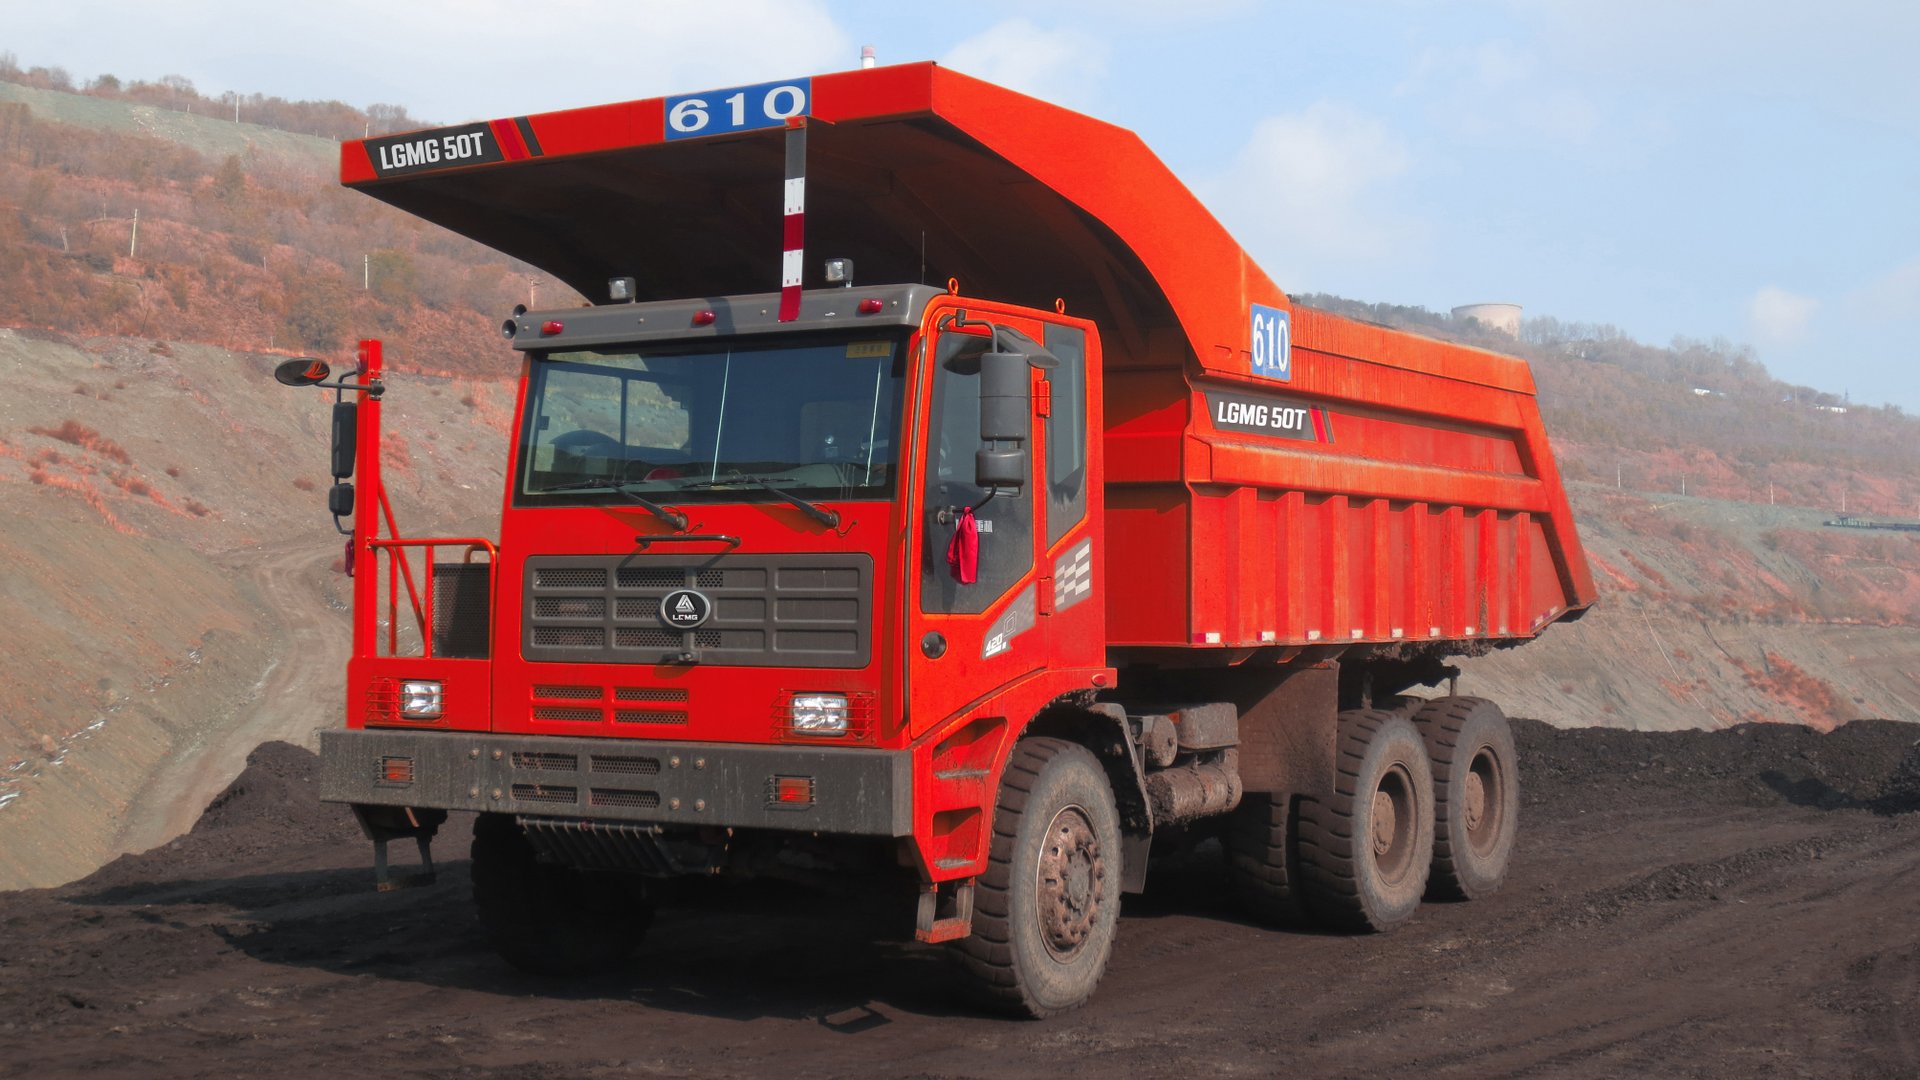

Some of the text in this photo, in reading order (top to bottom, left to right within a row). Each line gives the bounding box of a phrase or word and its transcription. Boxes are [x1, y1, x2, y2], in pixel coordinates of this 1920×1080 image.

[669, 85, 806, 133] 610
[379, 132, 484, 170] LGMG 50T
[1253, 313, 1289, 372] 610
[1217, 401, 1307, 430] LGMG 50T
